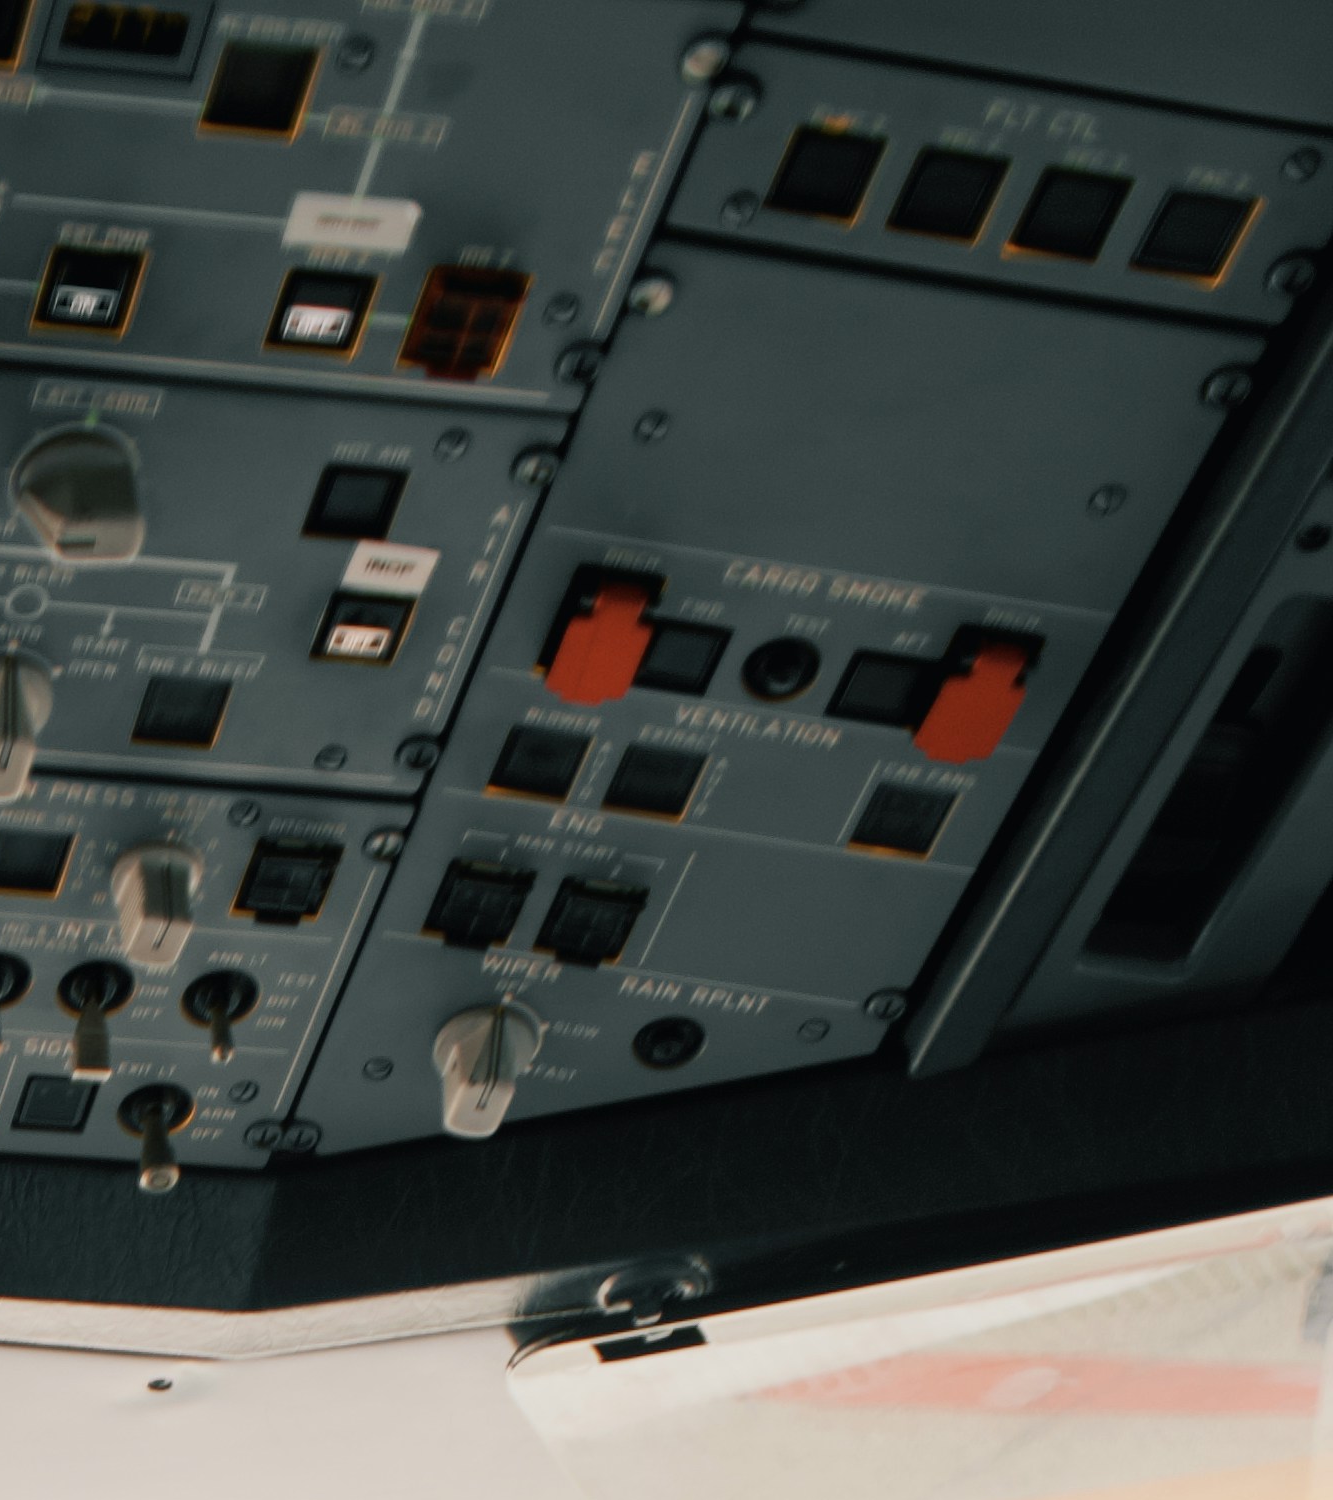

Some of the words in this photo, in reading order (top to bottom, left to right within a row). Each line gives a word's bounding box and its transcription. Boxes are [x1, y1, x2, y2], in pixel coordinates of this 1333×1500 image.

[723, 562, 820, 597] CARGO
[827, 577, 925, 613] SMOKE
[673, 704, 842, 749] VENTILATION
[479, 954, 564, 982] WIPER
[619, 977, 683, 1003] RAIN
[553, 1023, 598, 1039] SLOW
